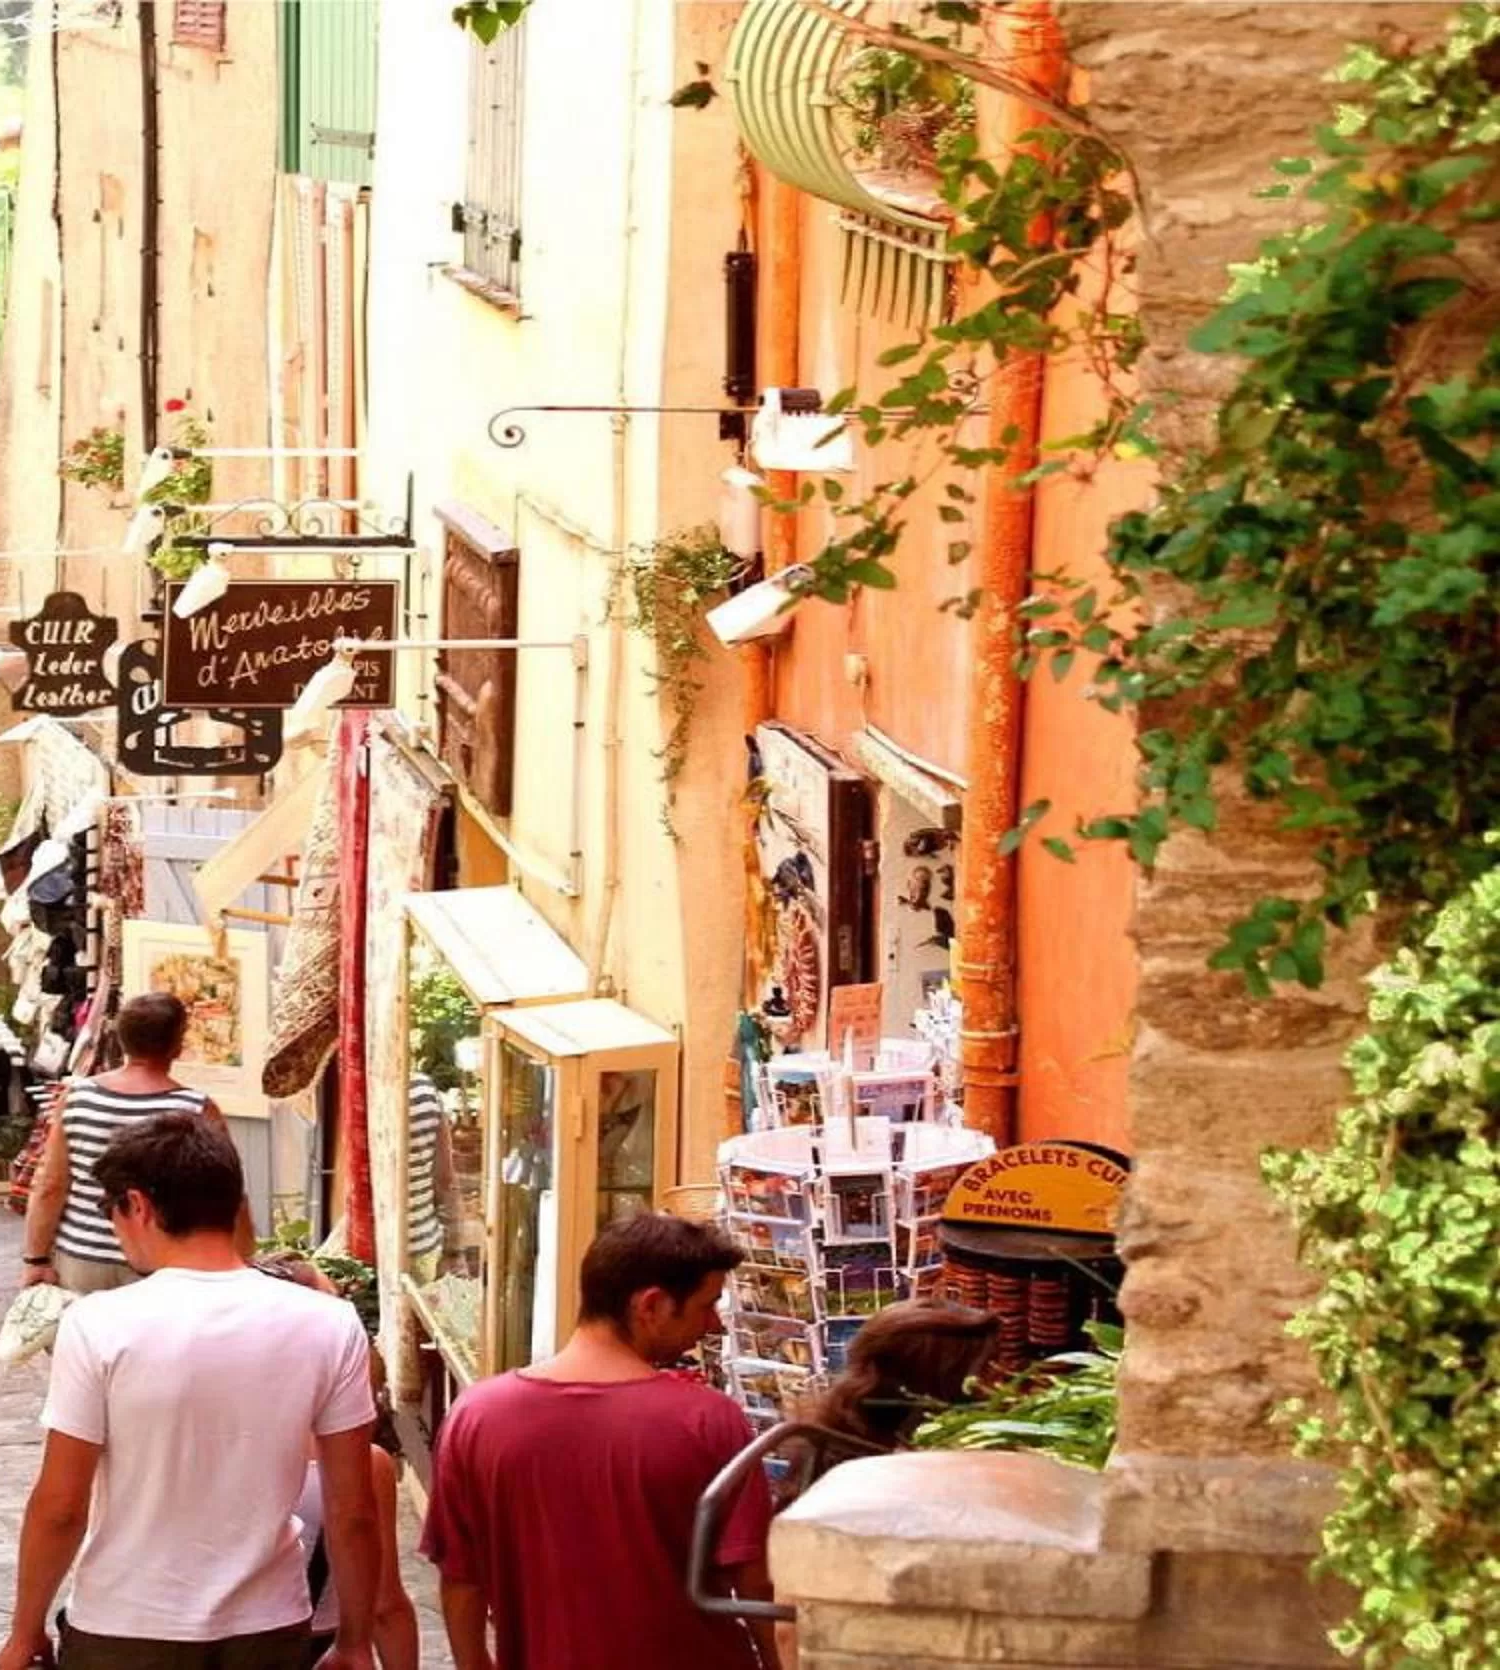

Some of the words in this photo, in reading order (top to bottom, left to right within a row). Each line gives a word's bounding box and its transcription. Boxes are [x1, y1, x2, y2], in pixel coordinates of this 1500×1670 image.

[24, 619, 97, 645] CUIR
[33, 651, 98, 676] Leder
[22, 682, 113, 709] Leather
[963, 1148, 1080, 1192] BRACELETS
[1086, 1158, 1128, 1186] CUI
[984, 1188, 1033, 1203] AVEC
[963, 1202, 1053, 1222] PRENOMS
